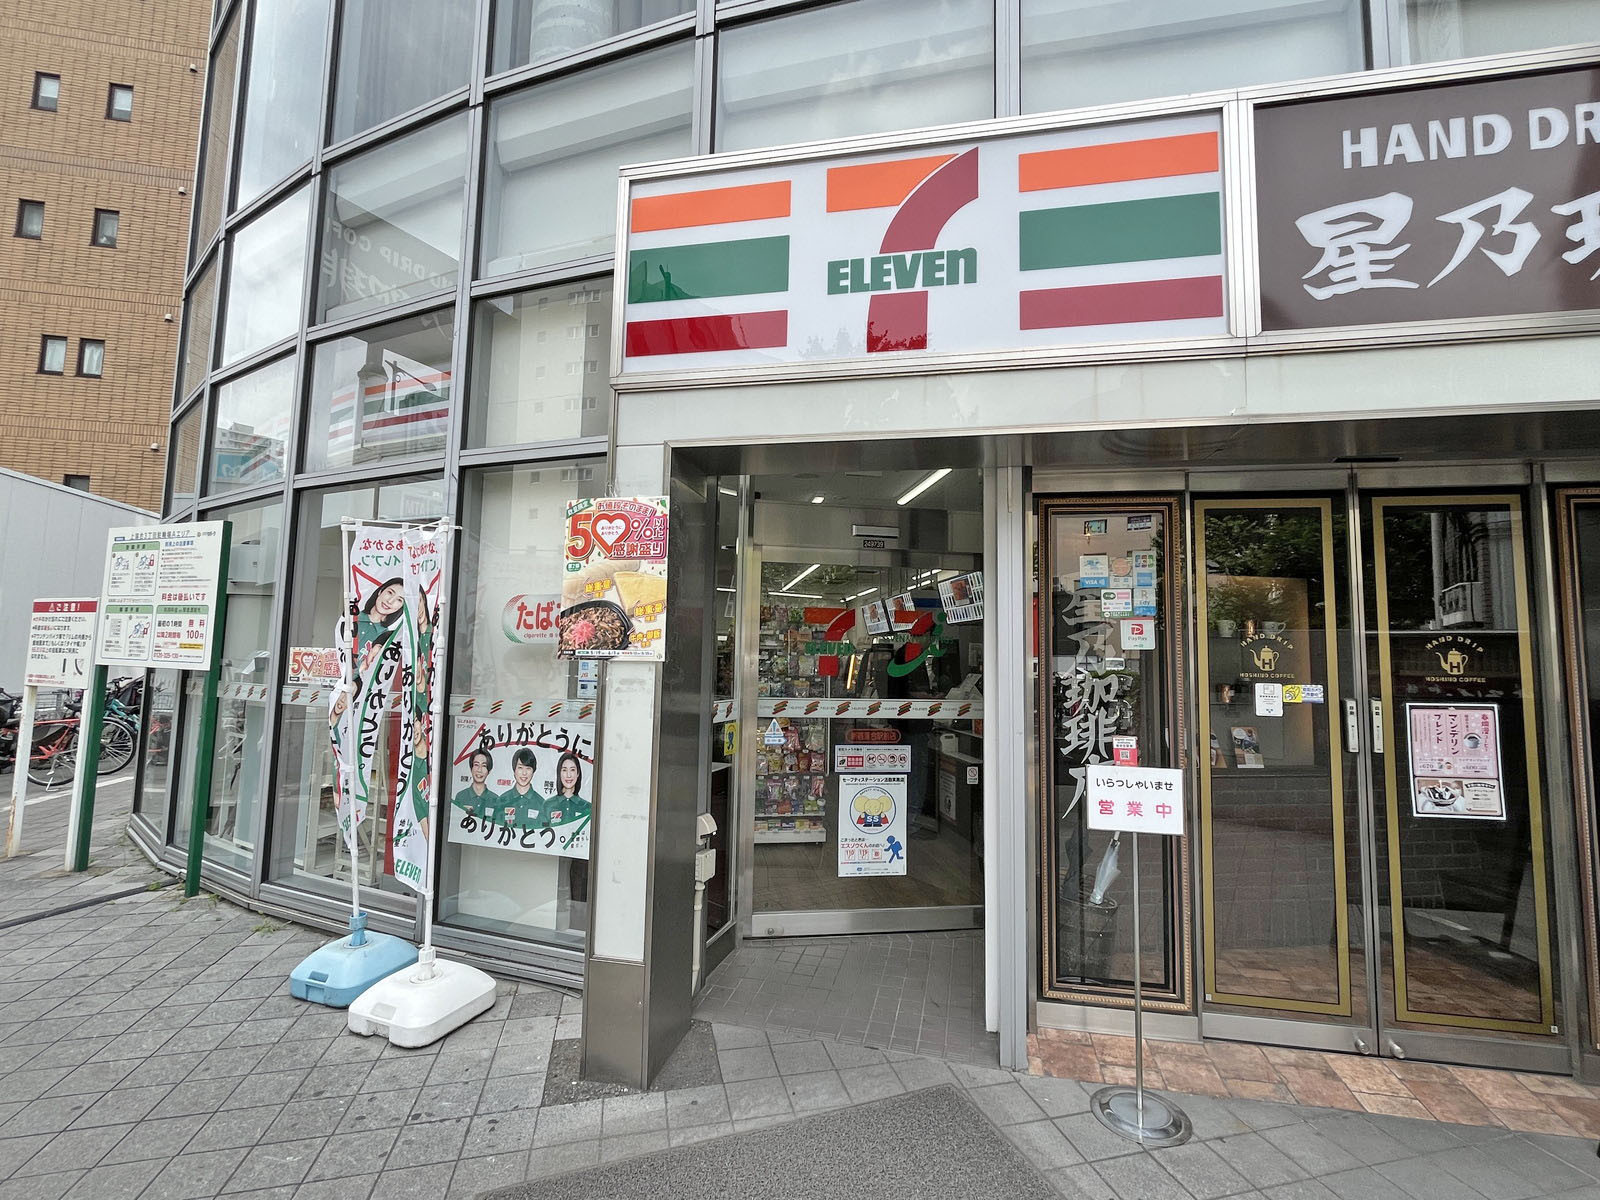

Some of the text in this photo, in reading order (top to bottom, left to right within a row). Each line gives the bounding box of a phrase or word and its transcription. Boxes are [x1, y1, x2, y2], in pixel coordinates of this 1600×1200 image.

[1342, 113, 1513, 169] HAND
[612, 542, 664, 557] 感謝盛り
[161, 592, 207, 601] 料金は後払いです
[186, 629, 205, 640] 100円
[1240, 633, 1294, 651] HAND DRIP
[1425, 635, 1484, 653] HAND DRIP
[1448, 714, 1460, 755] マンデリン
[1098, 799, 1173, 819] 営業中
[460, 806, 566, 849] ありがとう。
